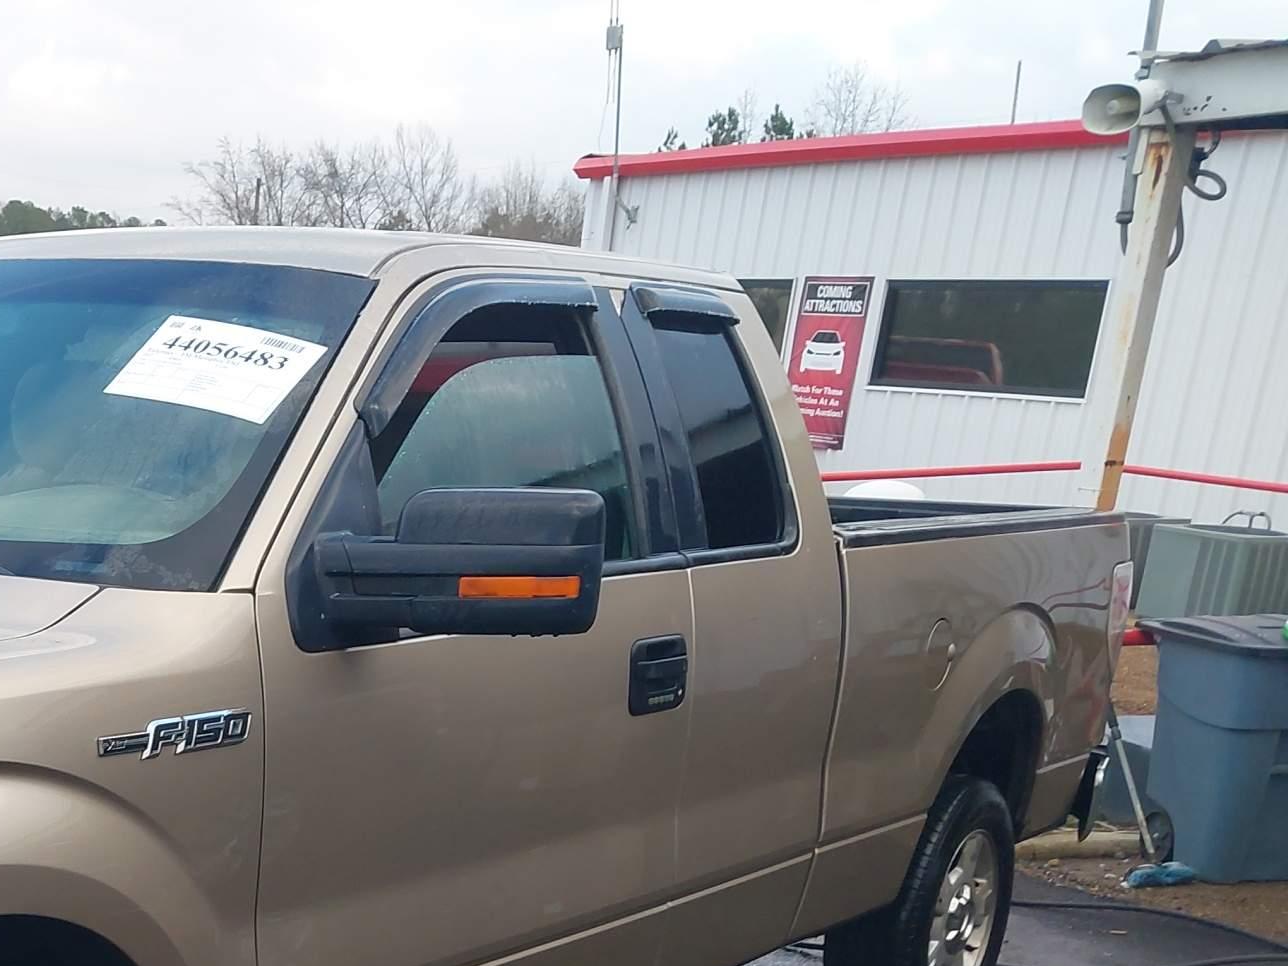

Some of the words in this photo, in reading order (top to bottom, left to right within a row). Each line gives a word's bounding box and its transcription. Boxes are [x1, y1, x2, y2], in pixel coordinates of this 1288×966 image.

[817, 284, 853, 299] COMING
[804, 299, 863, 313] ATTRACTIONS
[161, 335, 289, 371] 44056483
